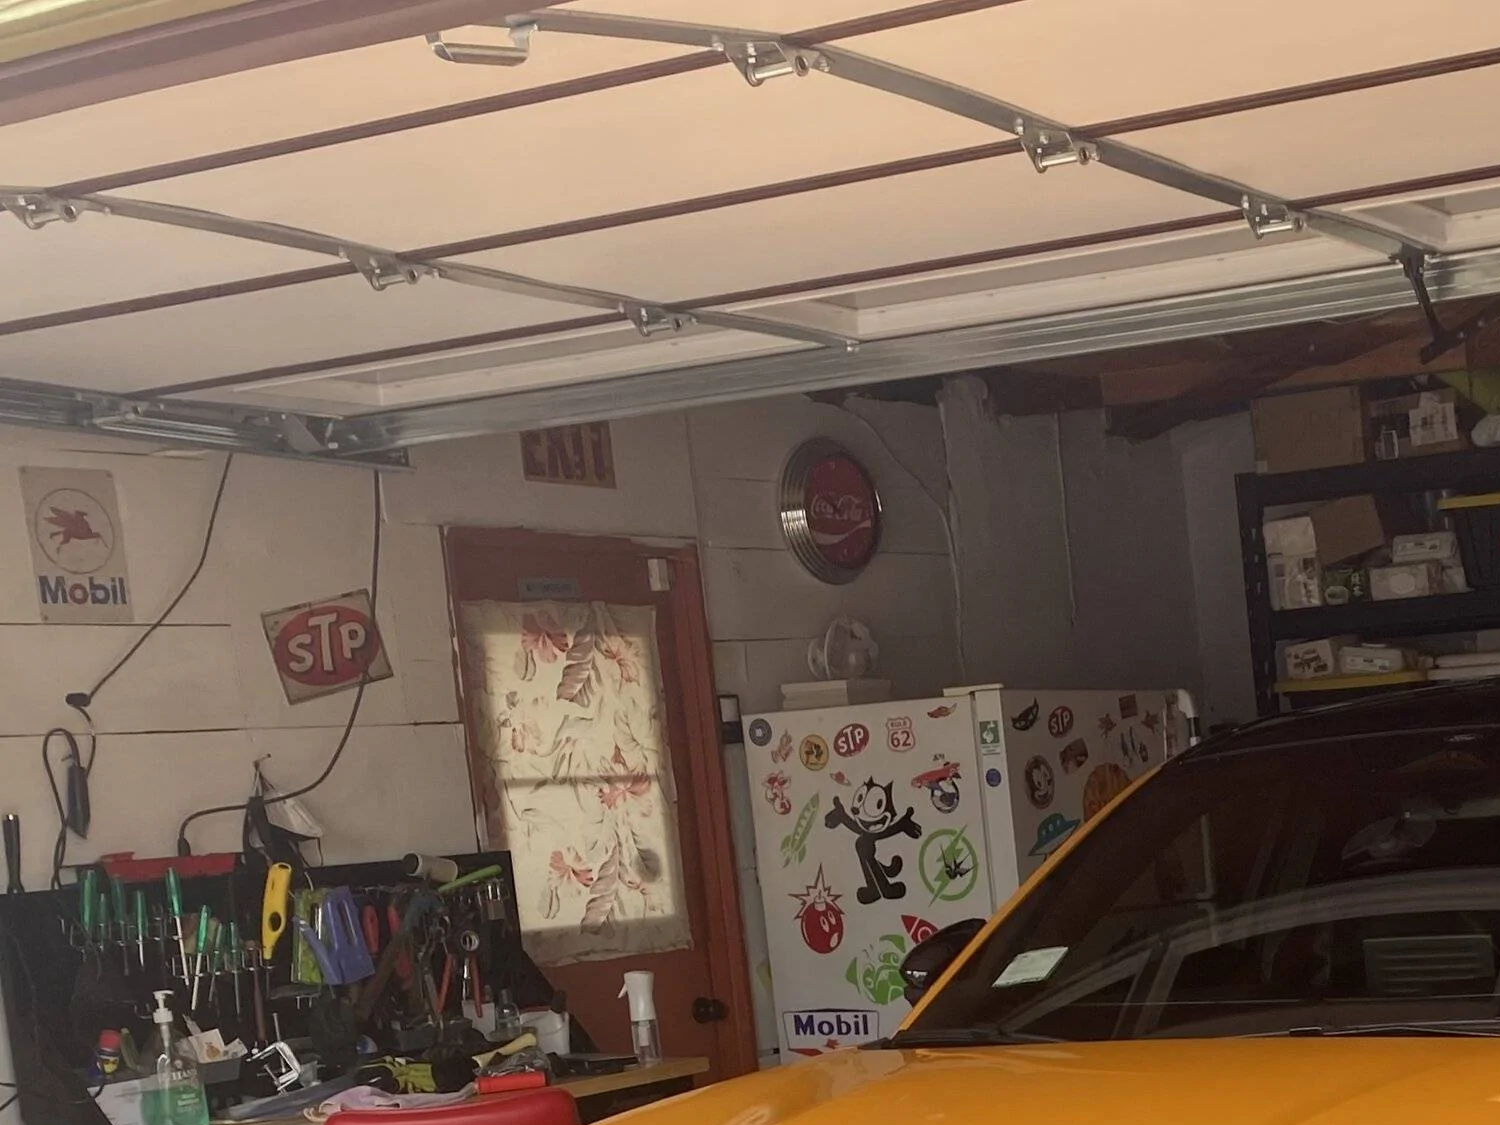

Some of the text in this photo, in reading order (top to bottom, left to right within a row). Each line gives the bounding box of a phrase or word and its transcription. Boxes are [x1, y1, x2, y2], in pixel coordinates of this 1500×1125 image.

[39, 576, 127, 606] Mobil
[288, 613, 366, 673] STP
[1050, 708, 1071, 736] STP
[838, 724, 864, 752] STP
[890, 729, 912, 748] 62
[794, 1014, 869, 1037] Mobil
